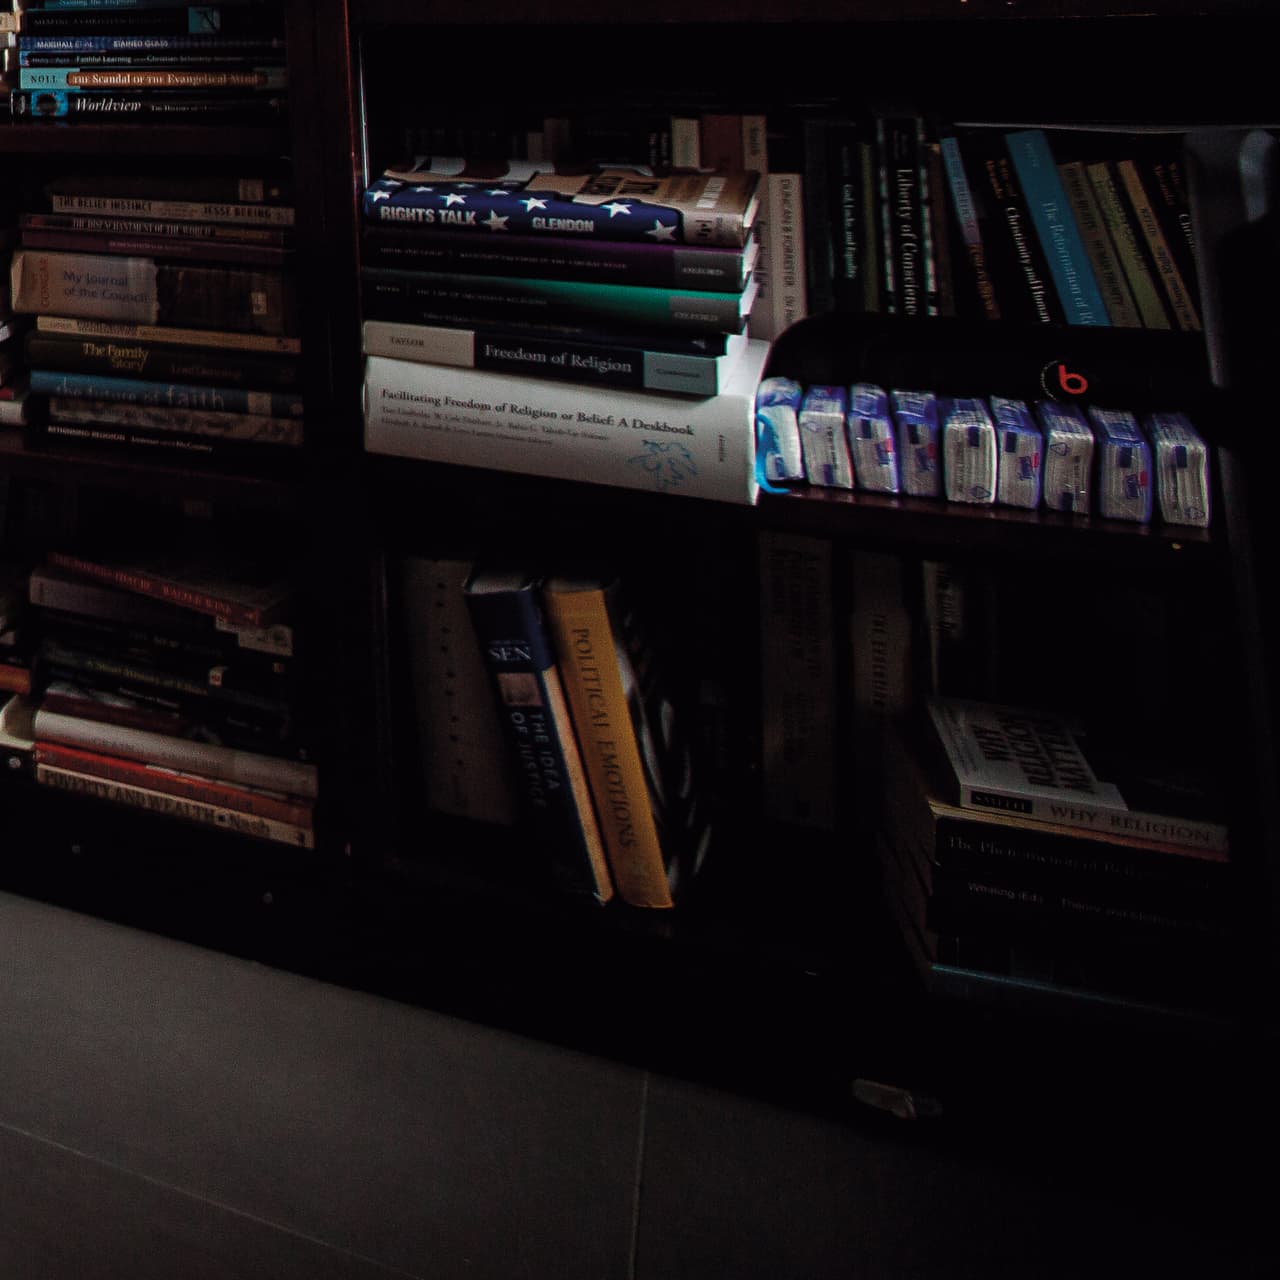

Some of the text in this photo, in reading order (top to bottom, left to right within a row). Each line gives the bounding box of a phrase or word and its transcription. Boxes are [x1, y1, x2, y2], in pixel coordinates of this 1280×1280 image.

[76, 97, 141, 112] Worldview
[380, 206, 594, 232] RIGHTS TALK GLENDON
[390, 337, 632, 374] TAYLOR Freedom of Religion
[382, 390, 694, 436] Facilitating Freedom of Religion or Belief: A Deskbook
[488, 645, 533, 661] SEN
[573, 627, 637, 848] POLITICAL EMOTIONS
